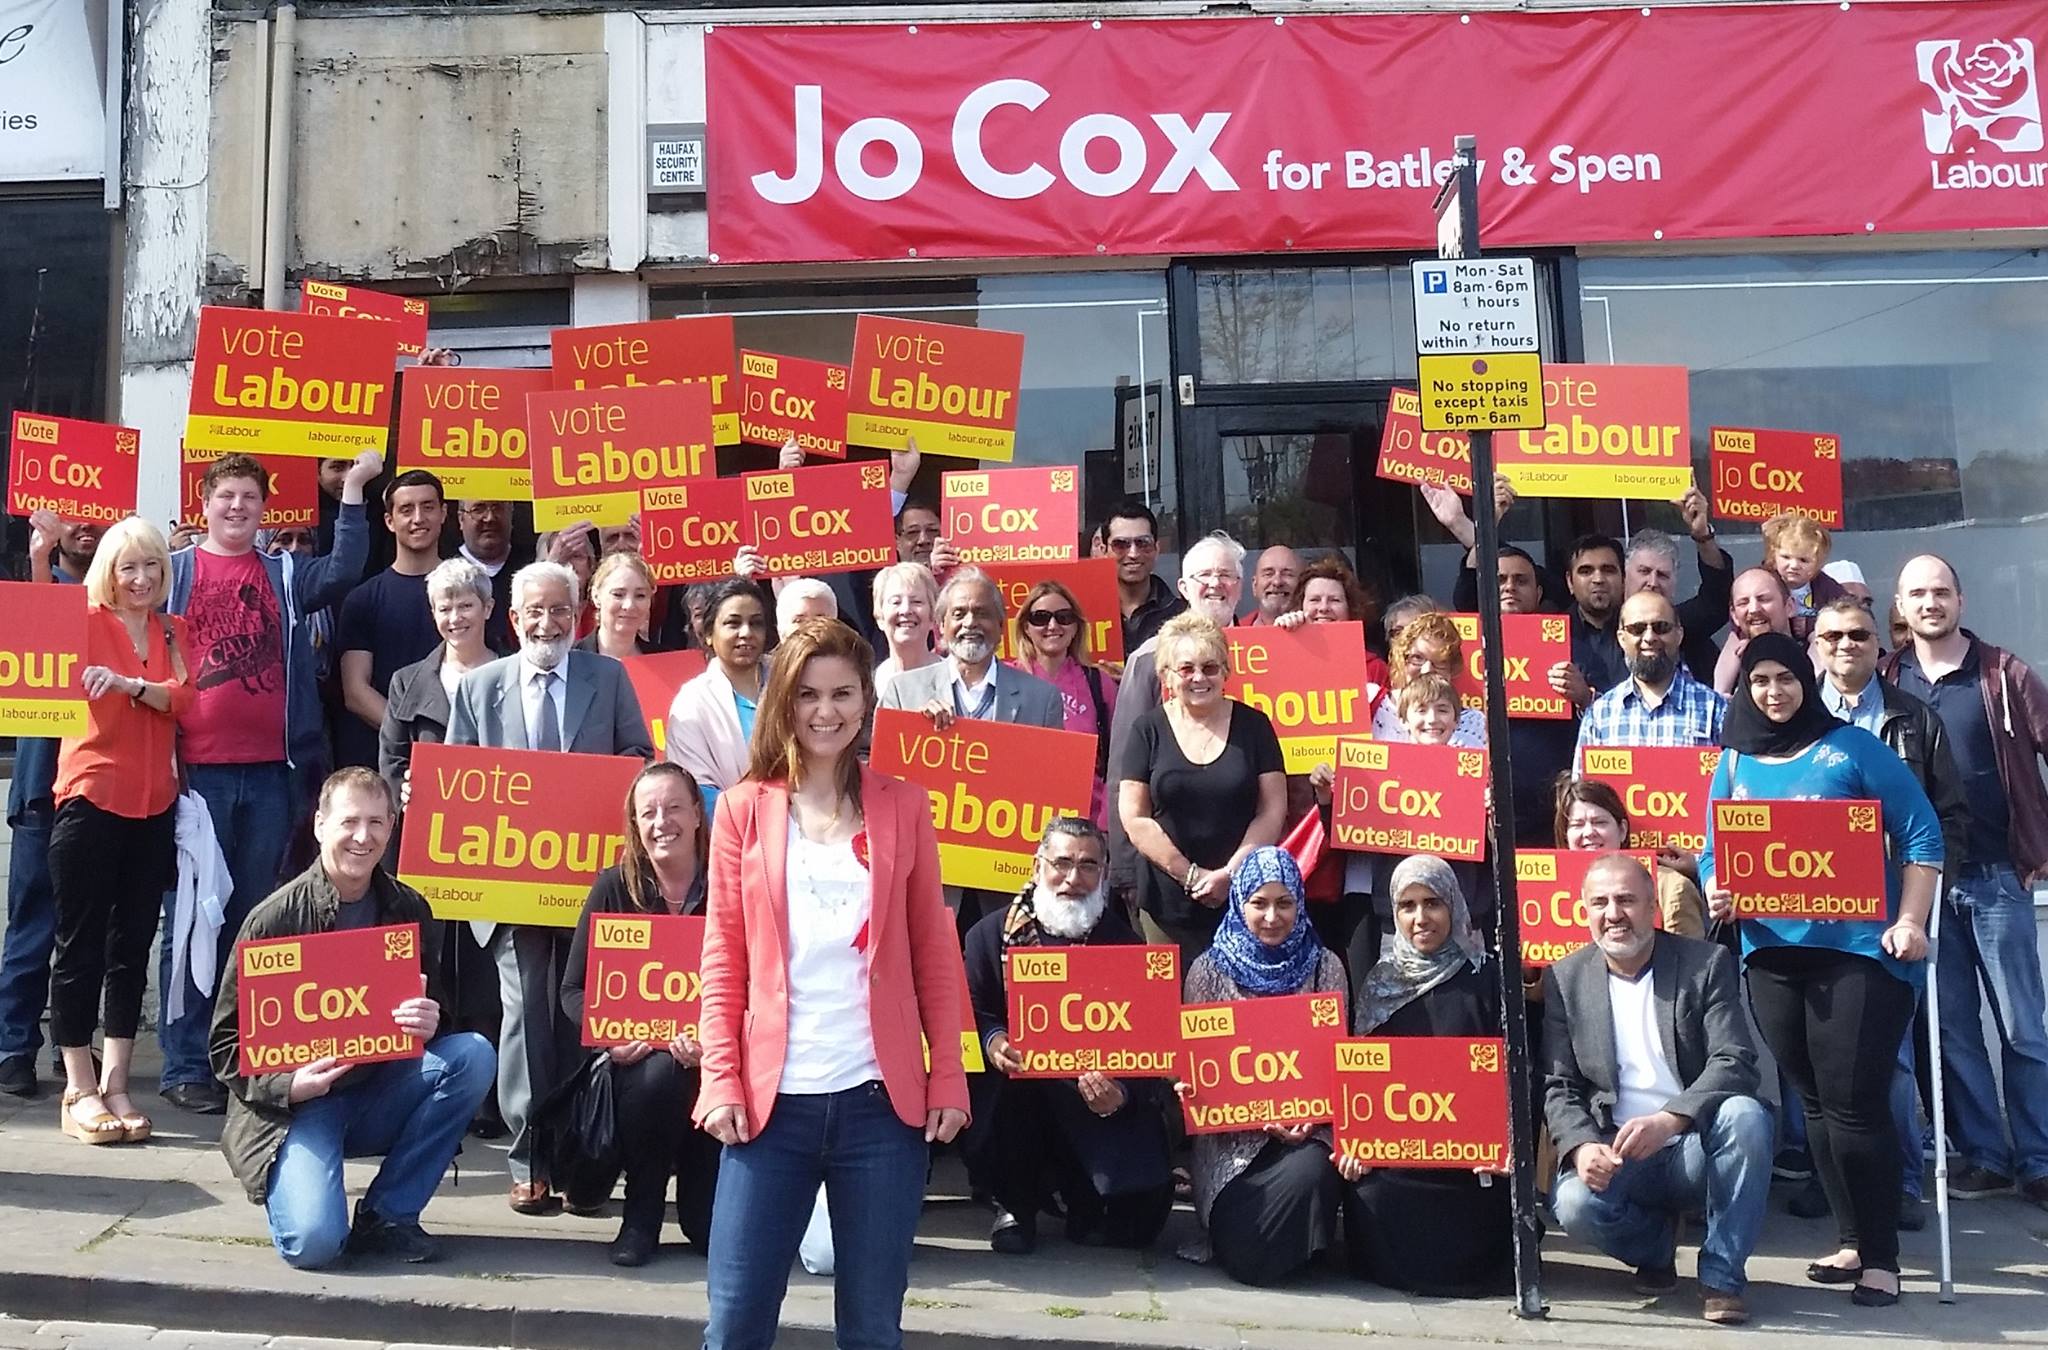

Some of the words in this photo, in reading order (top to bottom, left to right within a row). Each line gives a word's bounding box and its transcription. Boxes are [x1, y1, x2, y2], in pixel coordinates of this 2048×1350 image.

[0, 110, 38, 130] ies
[659, 143, 695, 155] HALIFAX
[751, 85, 923, 204] Jo
[952, 78, 1240, 200] Cox
[1263, 150, 1331, 190] for
[1501, 147, 1537, 186] &
[1549, 144, 1661, 193] Spen
[656, 156, 699, 169] SECURITY
[660, 170, 696, 183] CENTRE
[1931, 160, 2048, 189] Labour
[310, 283, 344, 299] Vote
[1478, 297, 1520, 308] hours
[1440, 320, 1461, 332] No
[1468, 319, 1516, 332] return
[221, 325, 304, 359] vote
[572, 336, 649, 369] vote
[876, 333, 945, 366] vote
[1422, 336, 1468, 349] within
[1491, 335, 1534, 347] hours
[746, 358, 775, 375] Vote
[213, 364, 384, 416] Labour
[424, 379, 500, 411] vote
[869, 367, 1011, 420] Labour
[1433, 380, 1454, 392] No
[1461, 379, 1528, 394] stopping
[1543, 376, 1598, 408] ote
[741, 383, 764, 416] Jo
[769, 387, 816, 421] Cox
[1398, 397, 1420, 413] Vot
[1434, 396, 1486, 411] except
[1492, 396, 1528, 408] taxis
[549, 402, 626, 436] vote
[21, 421, 54, 440] Vote
[219, 424, 262, 438] Labour
[308, 431, 377, 447] labour.org.uk
[420, 417, 527, 459] Labo
[741, 421, 779, 442] Vote
[874, 424, 909, 437] Labour
[948, 431, 1006, 448] labour.org.uk
[1518, 414, 1681, 457] Labour
[1384, 420, 1413, 453] Jo
[1420, 431, 1471, 463] Cox
[1718, 434, 1751, 449] Vote
[15, 449, 42, 486] Jo
[49, 454, 103, 490] Cox
[552, 441, 706, 487] Labour
[1382, 457, 1425, 480] Vote
[1438, 468, 1473, 491] Lab
[439, 475, 466, 486] bour
[950, 478, 984, 493] Vote
[1614, 473, 1681, 486] labour.org.uk
[1716, 459, 1742, 493] Jo
[1749, 461, 1804, 493] Cox
[648, 490, 683, 506] Vote
[752, 479, 789, 496] Vote
[13, 492, 60, 513] Vote
[564, 503, 603, 515] Labour
[1716, 498, 1761, 517] Vote
[260, 508, 314, 524] abour
[948, 506, 973, 541] Jo
[981, 503, 1039, 533] Cox
[648, 519, 674, 558] Jo
[682, 516, 740, 547] Cox
[752, 510, 781, 549] Jo
[789, 505, 853, 537] Cox
[823, 546, 892, 568] Labour
[1009, 543, 1073, 561] Labour
[650, 561, 697, 580] Vote
[1229, 640, 1268, 674] te
[1237, 683, 1359, 727] bour
[1508, 695, 1567, 713] abour
[2, 708, 77, 722] labour.org.uk
[898, 732, 989, 774] vote
[1345, 747, 1383, 764] Vote
[1590, 754, 1627, 770] Vote
[437, 764, 532, 805] vote
[1337, 776, 1369, 818] Jo
[1378, 779, 1443, 818] Cox
[1625, 783, 1689, 817] Cox
[927, 782, 1078, 842] abou
[1723, 810, 1765, 826] Vote
[428, 812, 626, 873] Labour
[1336, 825, 1393, 846] Vote
[1406, 830, 1479, 855] Labour
[1658, 831, 1706, 850] Labo
[1721, 842, 1754, 886] Jo
[1764, 842, 1836, 878] Cox
[435, 888, 484, 902] Labour
[1801, 893, 1880, 914] Labour
[1522, 900, 1542, 926] o
[1550, 890, 1591, 927] Co
[601, 924, 645, 943] Vote
[250, 952, 295, 970] Vote
[1018, 959, 1061, 976] Vote
[589, 960, 627, 1009] Jo
[245, 988, 282, 1039] Jo
[293, 982, 370, 1023] Cox
[1014, 994, 1049, 1042] Jo
[1059, 993, 1133, 1033] Cox
[588, 1016, 651, 1040] Vote
[1185, 1014, 1229, 1034] Vote
[246, 1043, 311, 1068] Vote
[1095, 1049, 1177, 1071] Labour
[1340, 1047, 1385, 1066] Vote
[1188, 1051, 1220, 1098] Jo
[1229, 1045, 1304, 1086] Cox
[1189, 1103, 1250, 1128] Vote
[1267, 1097, 1333, 1121] Labou
[1339, 1083, 1373, 1131] Jo
[1384, 1083, 1457, 1123] Cox
[1339, 1137, 1402, 1161] Vote
[1420, 1138, 1503, 1161] Labour
